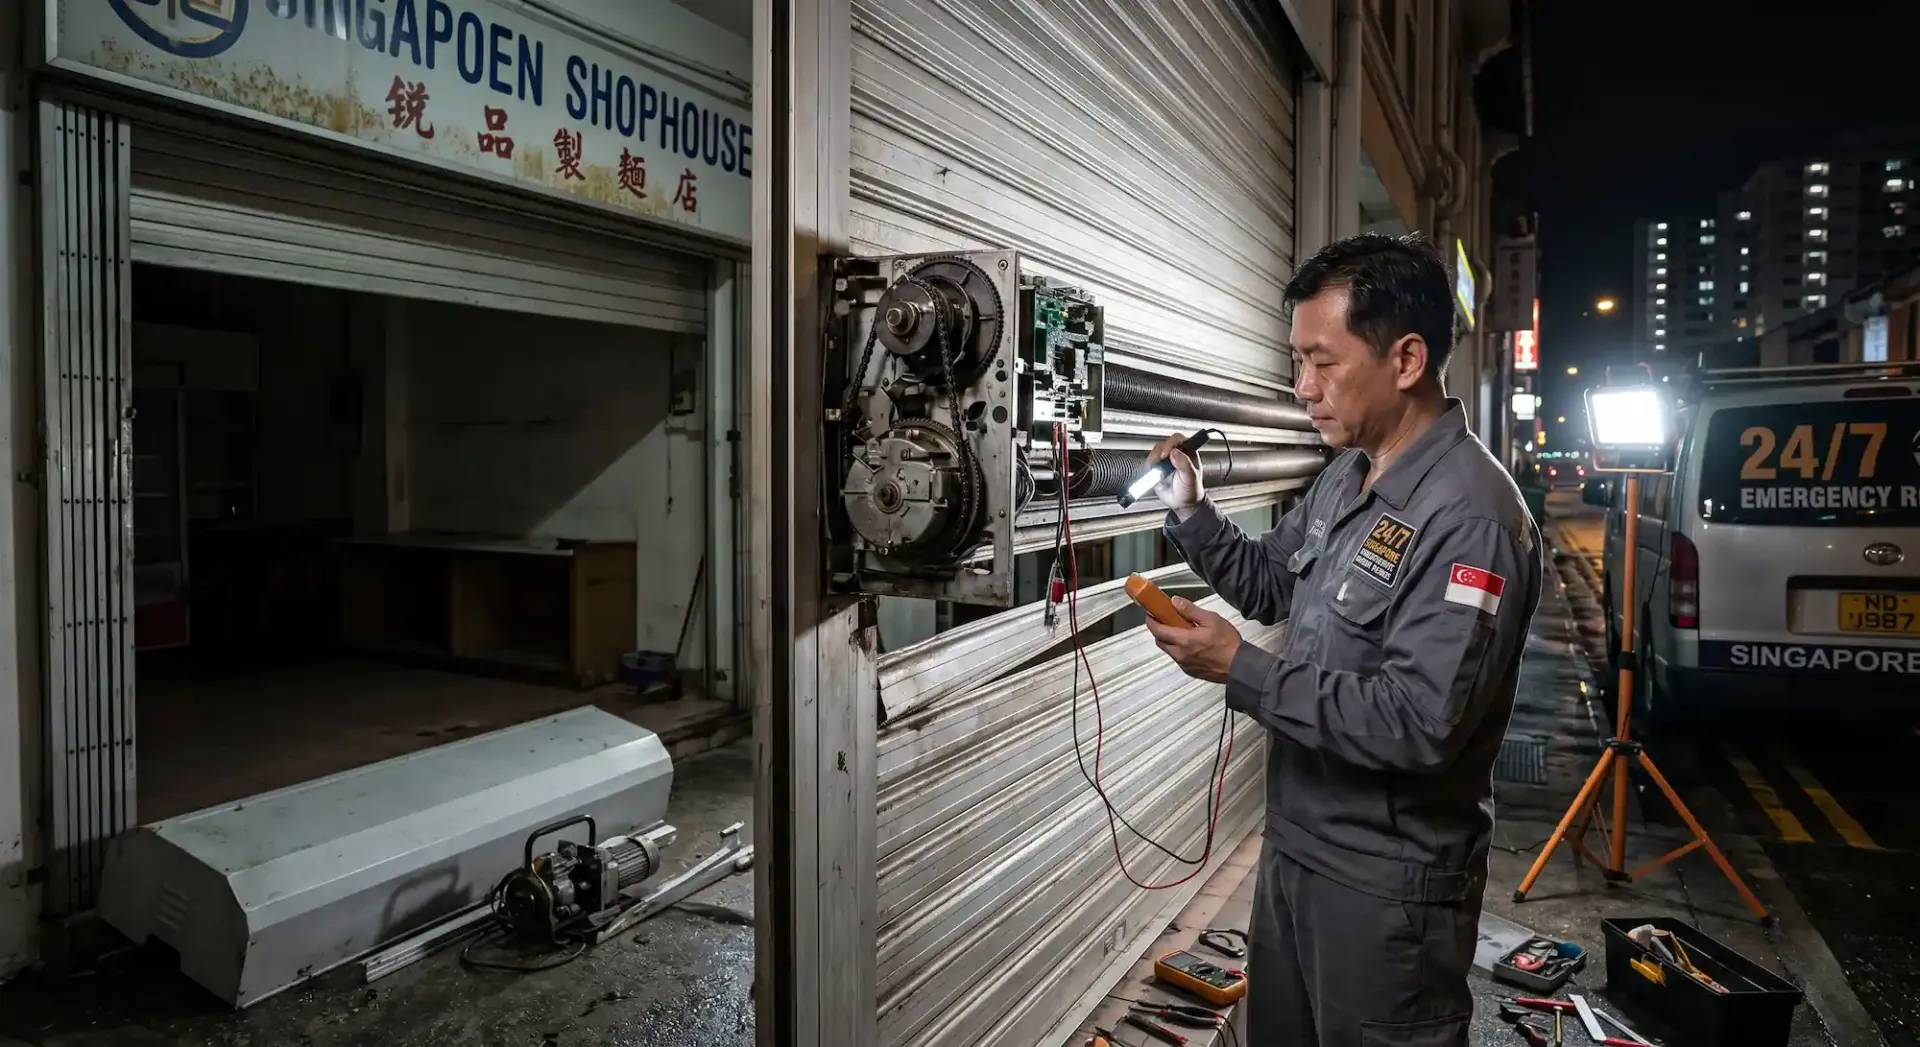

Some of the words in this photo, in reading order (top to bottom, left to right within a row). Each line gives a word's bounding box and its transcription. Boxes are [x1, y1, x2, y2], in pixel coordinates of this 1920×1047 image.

[265, 0, 544, 107] GAPOEN
[566, 55, 752, 179] SHOPHOUSE
[1739, 422, 1888, 481] 24/7
[1740, 485, 1892, 509] EMERGENCY
[1900, 485, 1920, 508] R
[1371, 519, 1412, 550] 24/7
[1729, 644, 1920, 674] SINGAPORE
